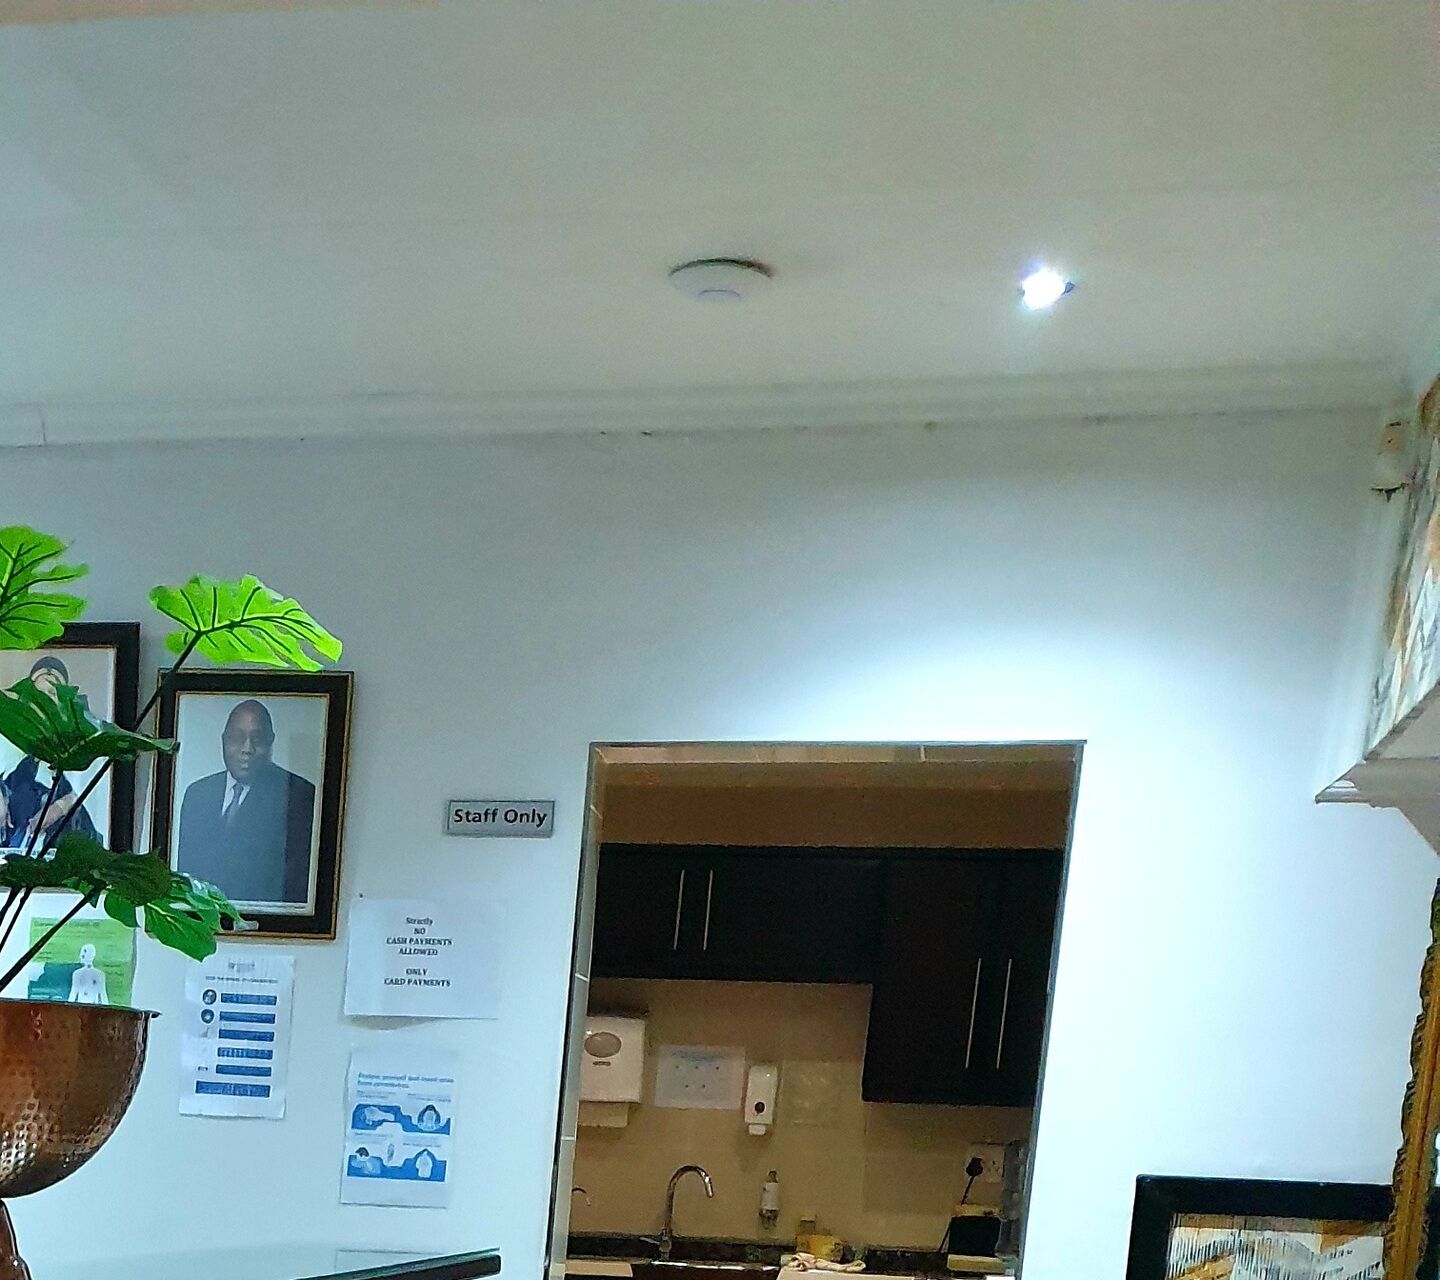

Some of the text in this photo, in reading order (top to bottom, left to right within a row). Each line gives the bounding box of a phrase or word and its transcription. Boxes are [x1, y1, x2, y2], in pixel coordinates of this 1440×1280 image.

[454, 808, 547, 828] Staff Only
[386, 937, 452, 946] CASH PAYMENTS
[399, 948, 438, 956] ALLOWED
[406, 968, 427, 976] ONLY
[384, 978, 451, 987] CARD PAYMENTS
